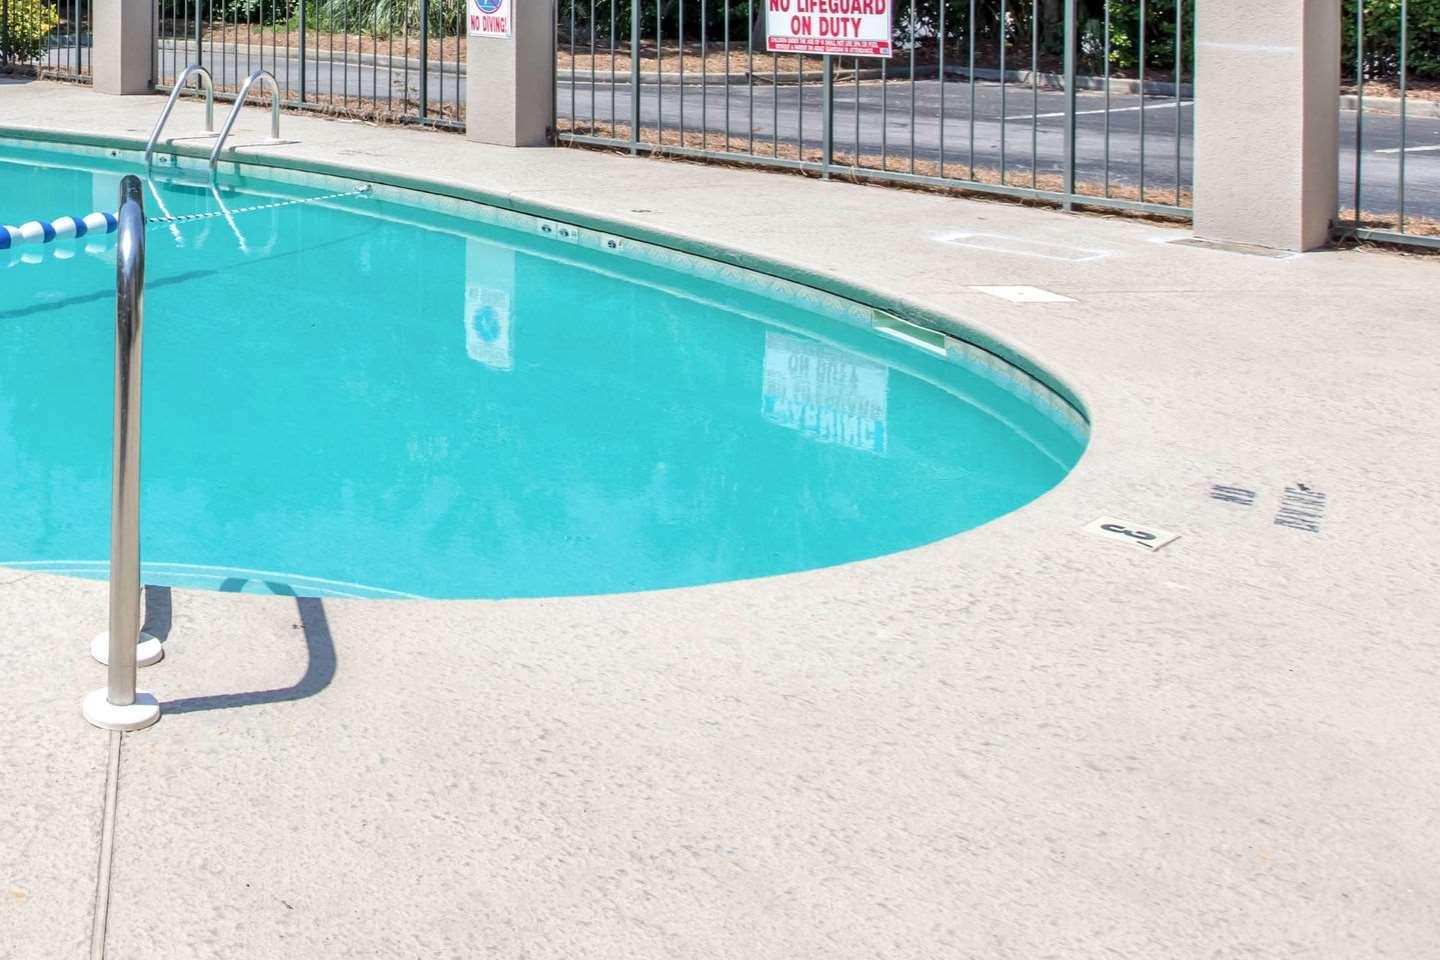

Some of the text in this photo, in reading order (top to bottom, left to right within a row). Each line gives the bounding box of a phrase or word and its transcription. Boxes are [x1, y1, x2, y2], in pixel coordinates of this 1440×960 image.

[471, 15, 507, 33] NO DIVING!
[790, 15, 862, 37] ON DUTY
[1210, 484, 1256, 506] NO
[1273, 487, 1327, 533] DIVING
